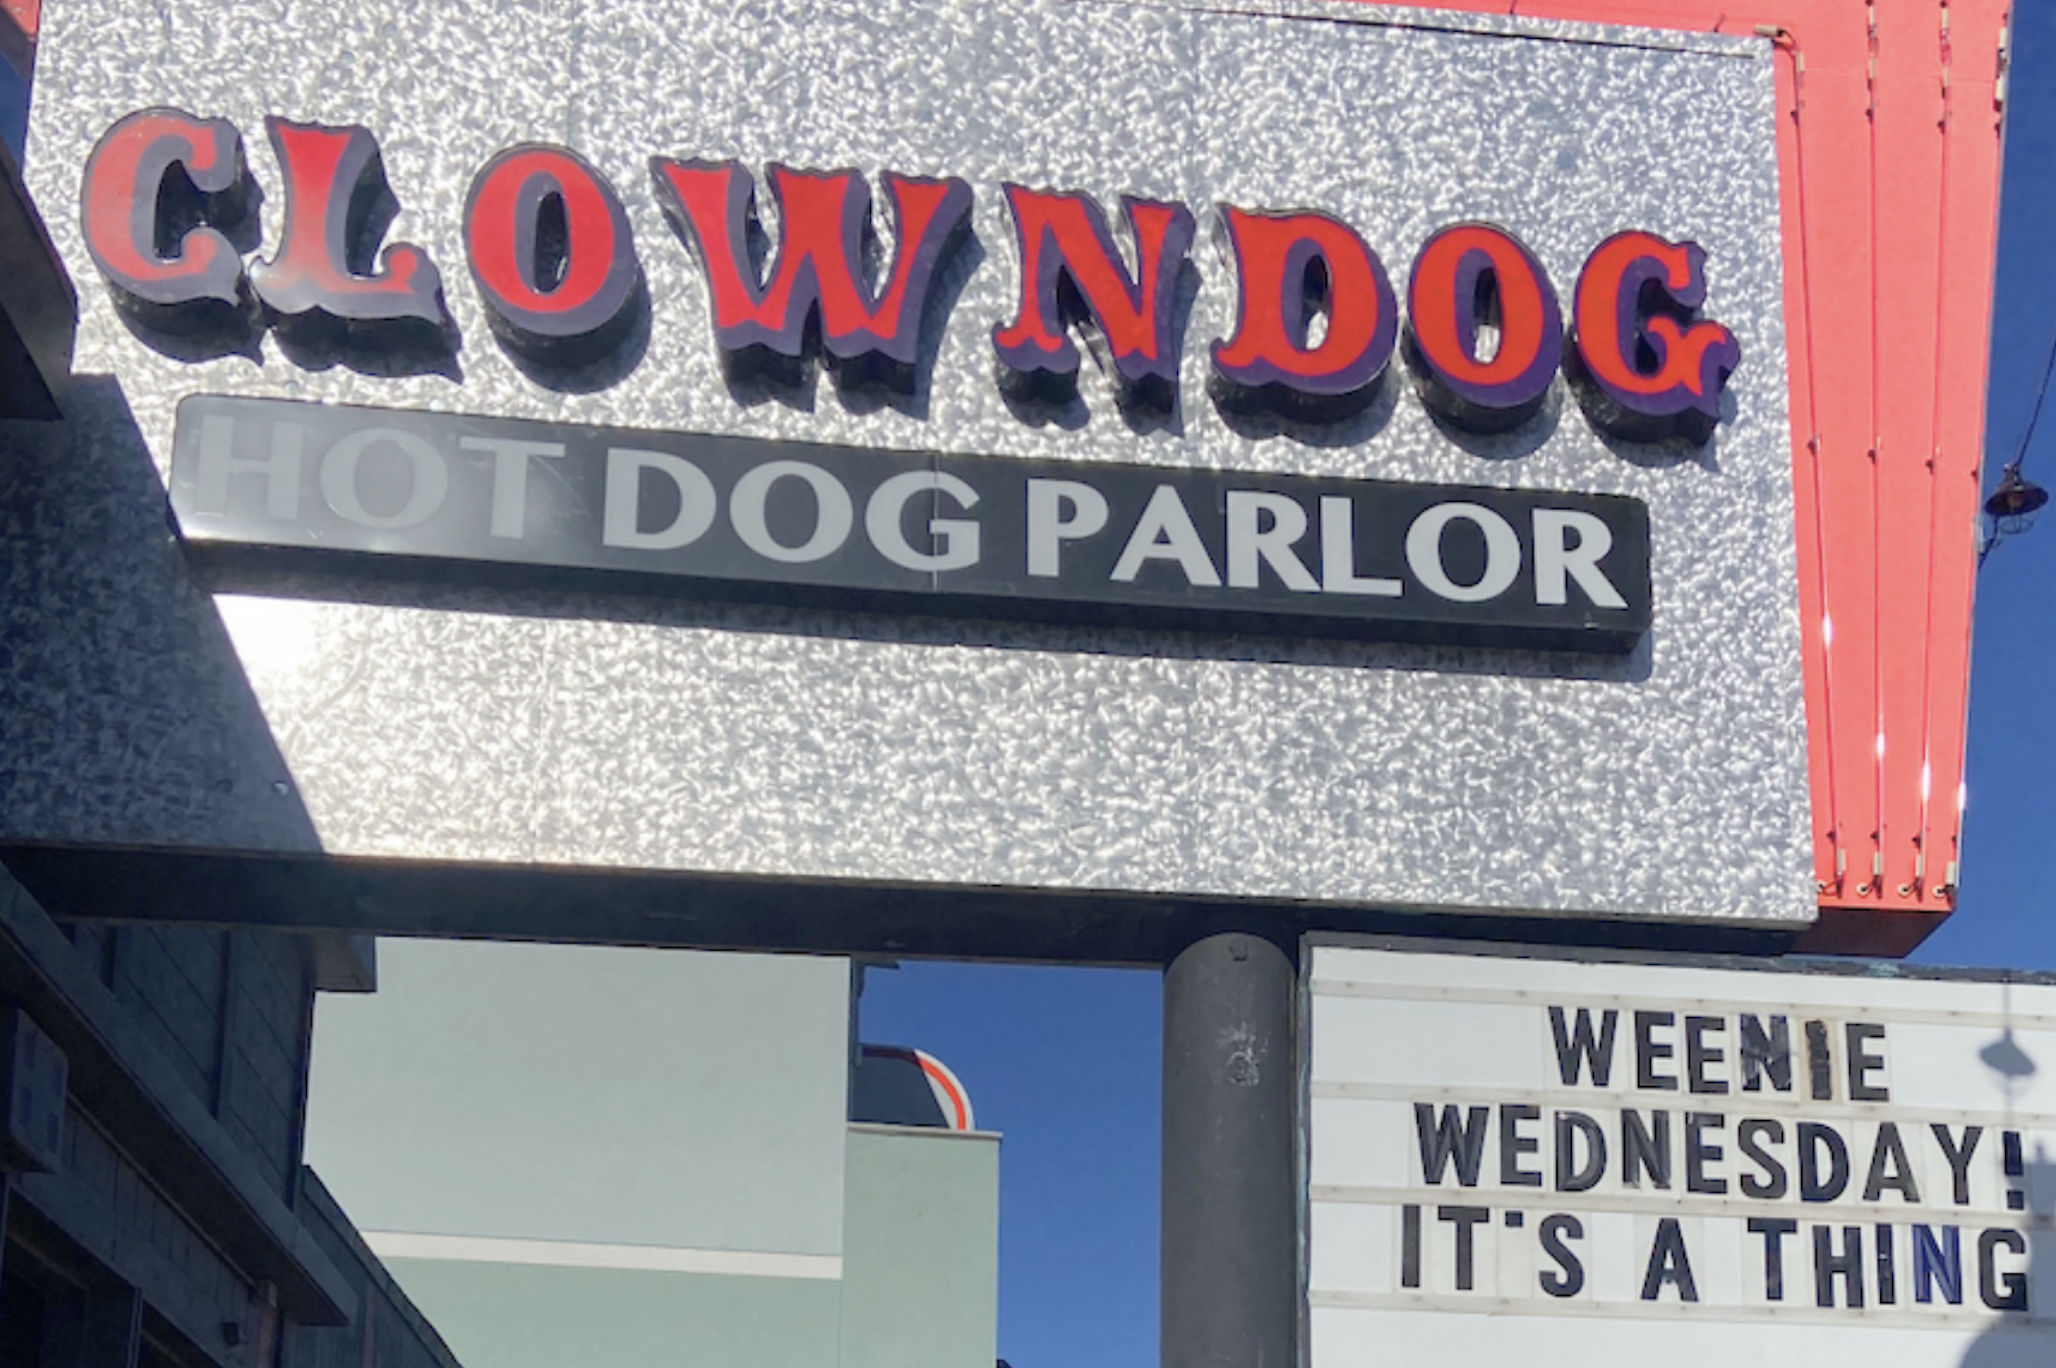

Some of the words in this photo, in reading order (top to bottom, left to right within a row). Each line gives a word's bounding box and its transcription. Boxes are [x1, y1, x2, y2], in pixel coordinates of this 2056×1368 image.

[192, 414, 566, 540] HOT
[603, 447, 981, 571] DOG
[1026, 477, 1629, 610] PARLOR
[1547, 1005, 1891, 1103] WEENIE
[1413, 1102, 2026, 1211] WEDNESDAY!
[1401, 1204, 1586, 1299] IT'S
[1640, 1217, 1700, 1303] A
[1746, 1217, 2029, 1313] THING
